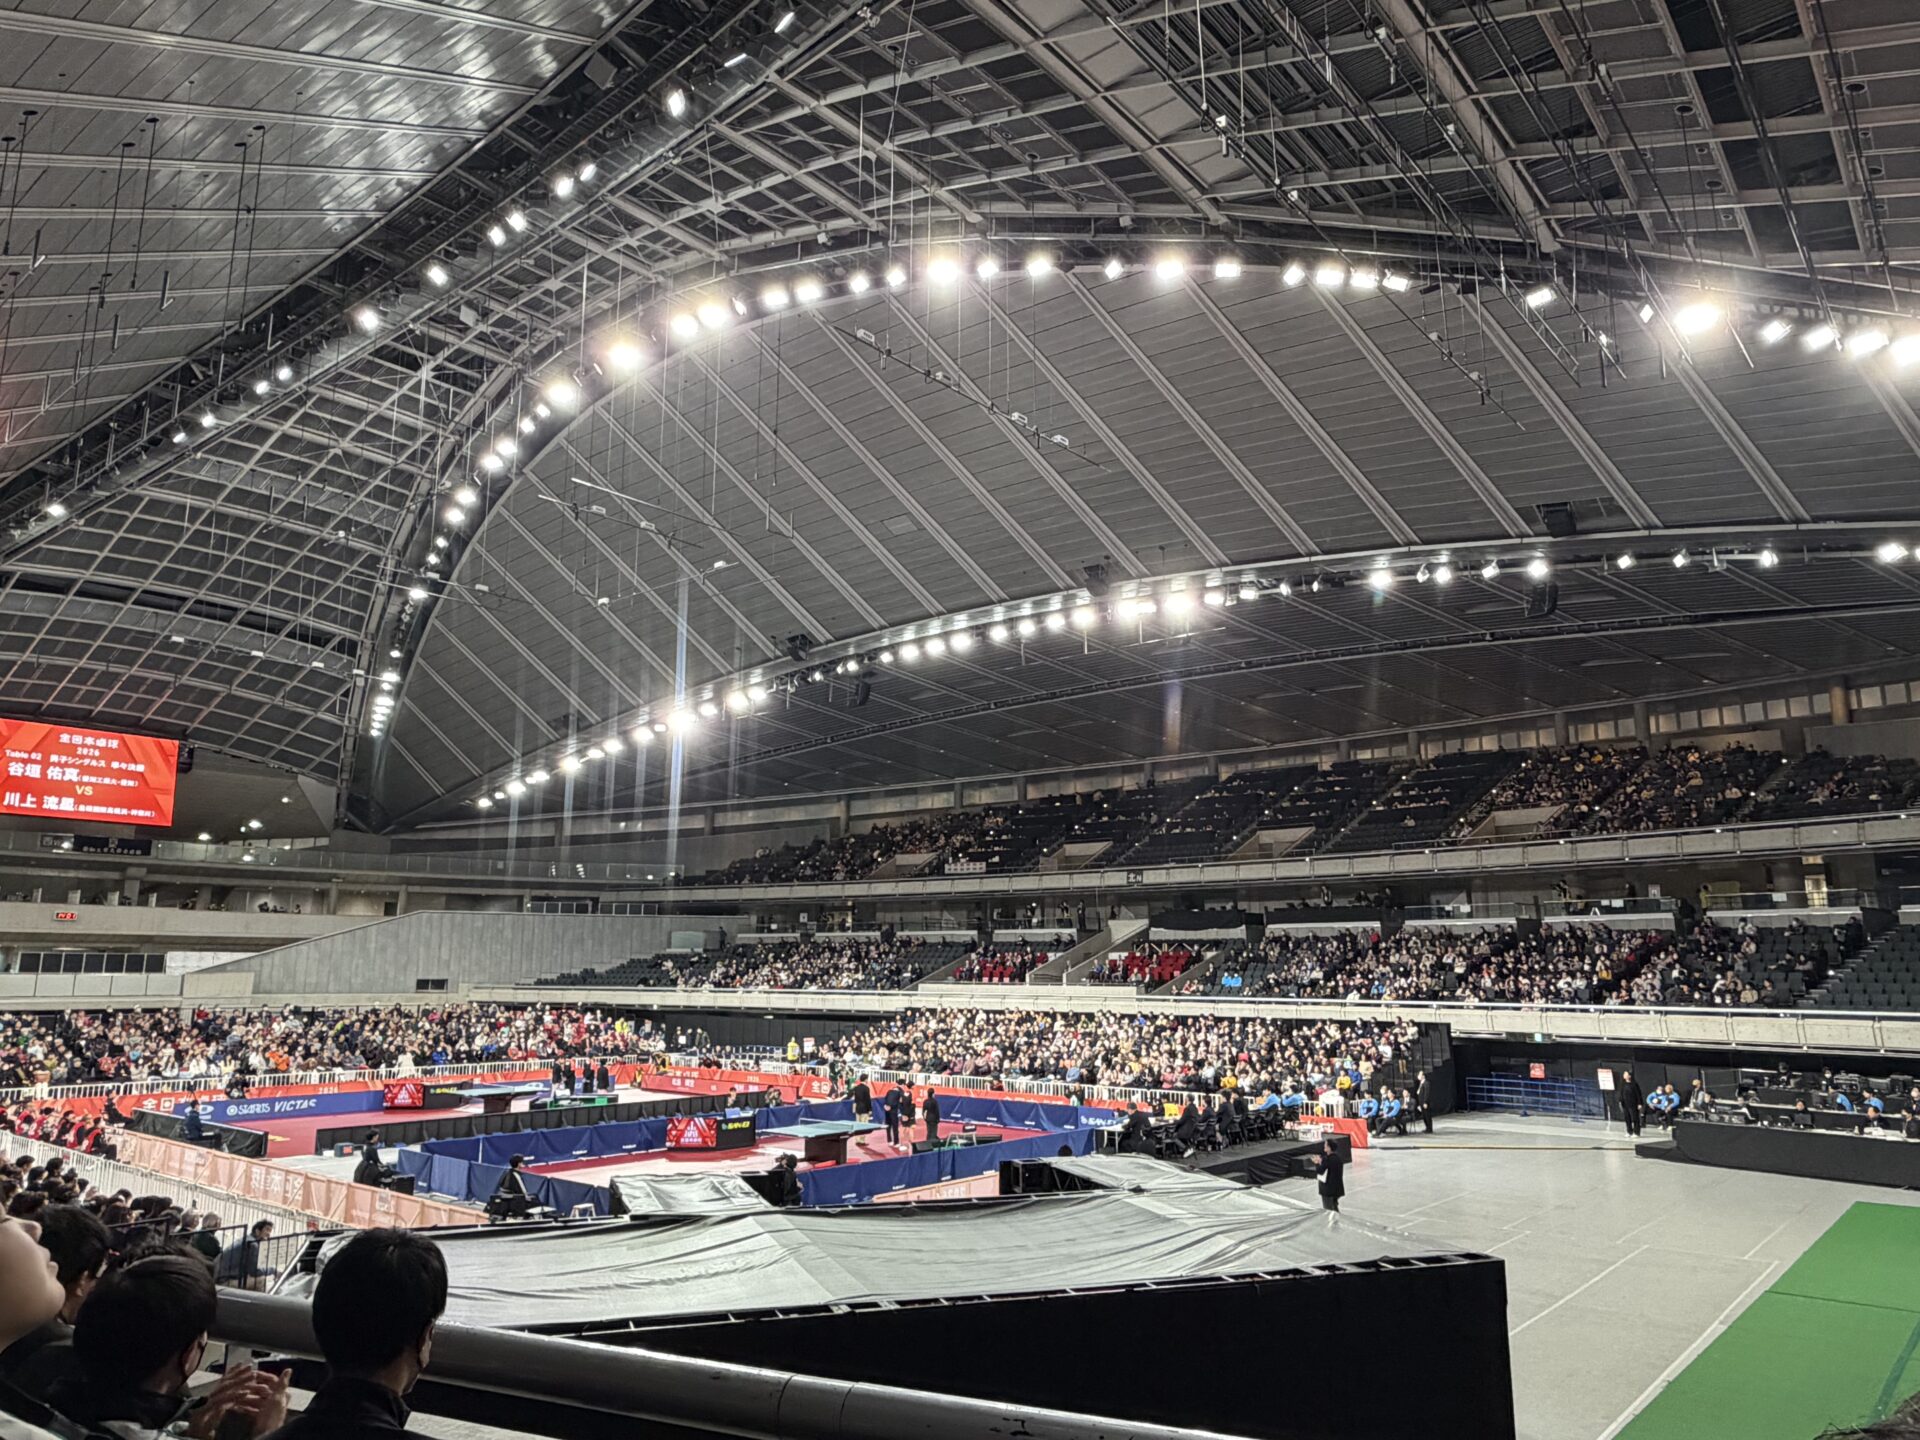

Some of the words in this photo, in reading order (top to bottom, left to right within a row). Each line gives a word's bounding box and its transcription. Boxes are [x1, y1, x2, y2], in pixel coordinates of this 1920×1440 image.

[59, 733, 119, 749] 全日本卓球
[5, 749, 29, 759] Table
[30, 752, 42, 760] 02
[50, 754, 106, 768] 男子シングルス
[76, 747, 100, 757] 2026
[8, 761, 42, 779] 谷垣
[75, 785, 94, 796] VS
[3, 791, 37, 808] 川上
[274, 1099, 317, 1112] VICTAS
